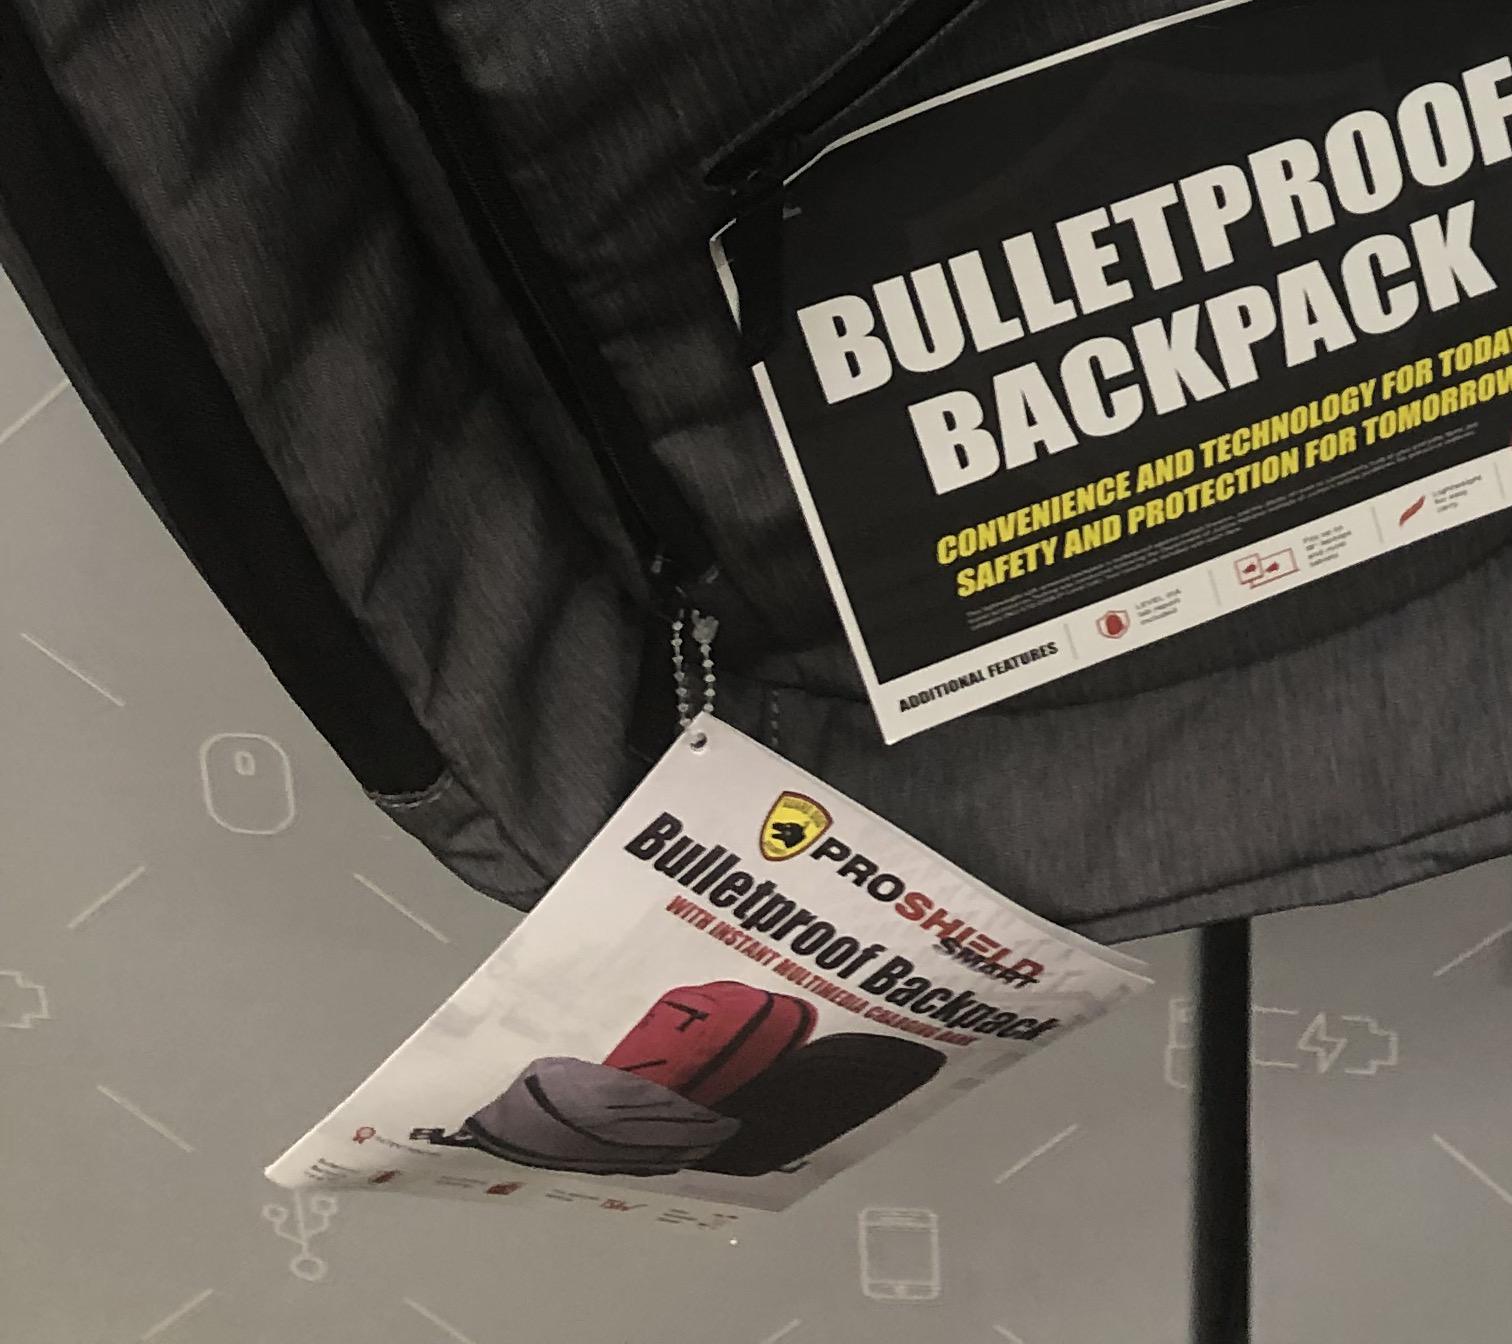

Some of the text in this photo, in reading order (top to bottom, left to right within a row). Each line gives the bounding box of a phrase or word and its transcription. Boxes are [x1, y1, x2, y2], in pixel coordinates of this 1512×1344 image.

[907, 199, 1498, 496] BACKPACK
[937, 475, 1132, 565] CONVENIENCE
[1136, 448, 1195, 493] AND
[1200, 381, 1375, 468] TECHNOLOGY
[1381, 357, 1433, 401] FOR
[957, 536, 1059, 597] SAFETY
[1063, 514, 1122, 559] AND
[1128, 446, 1299, 535] PROTECTION
[1305, 426, 1357, 469] FOR
[899, 642, 1058, 712] ADDITIONAL FEATURES
[624, 812, 1060, 1041] Bulletproof Backpack
[665, 895, 713, 932] WITH
[711, 919, 785, 968] INSTANT
[810, 837, 1044, 979] PROSHIELD
[933, 937, 1039, 988] SMART
